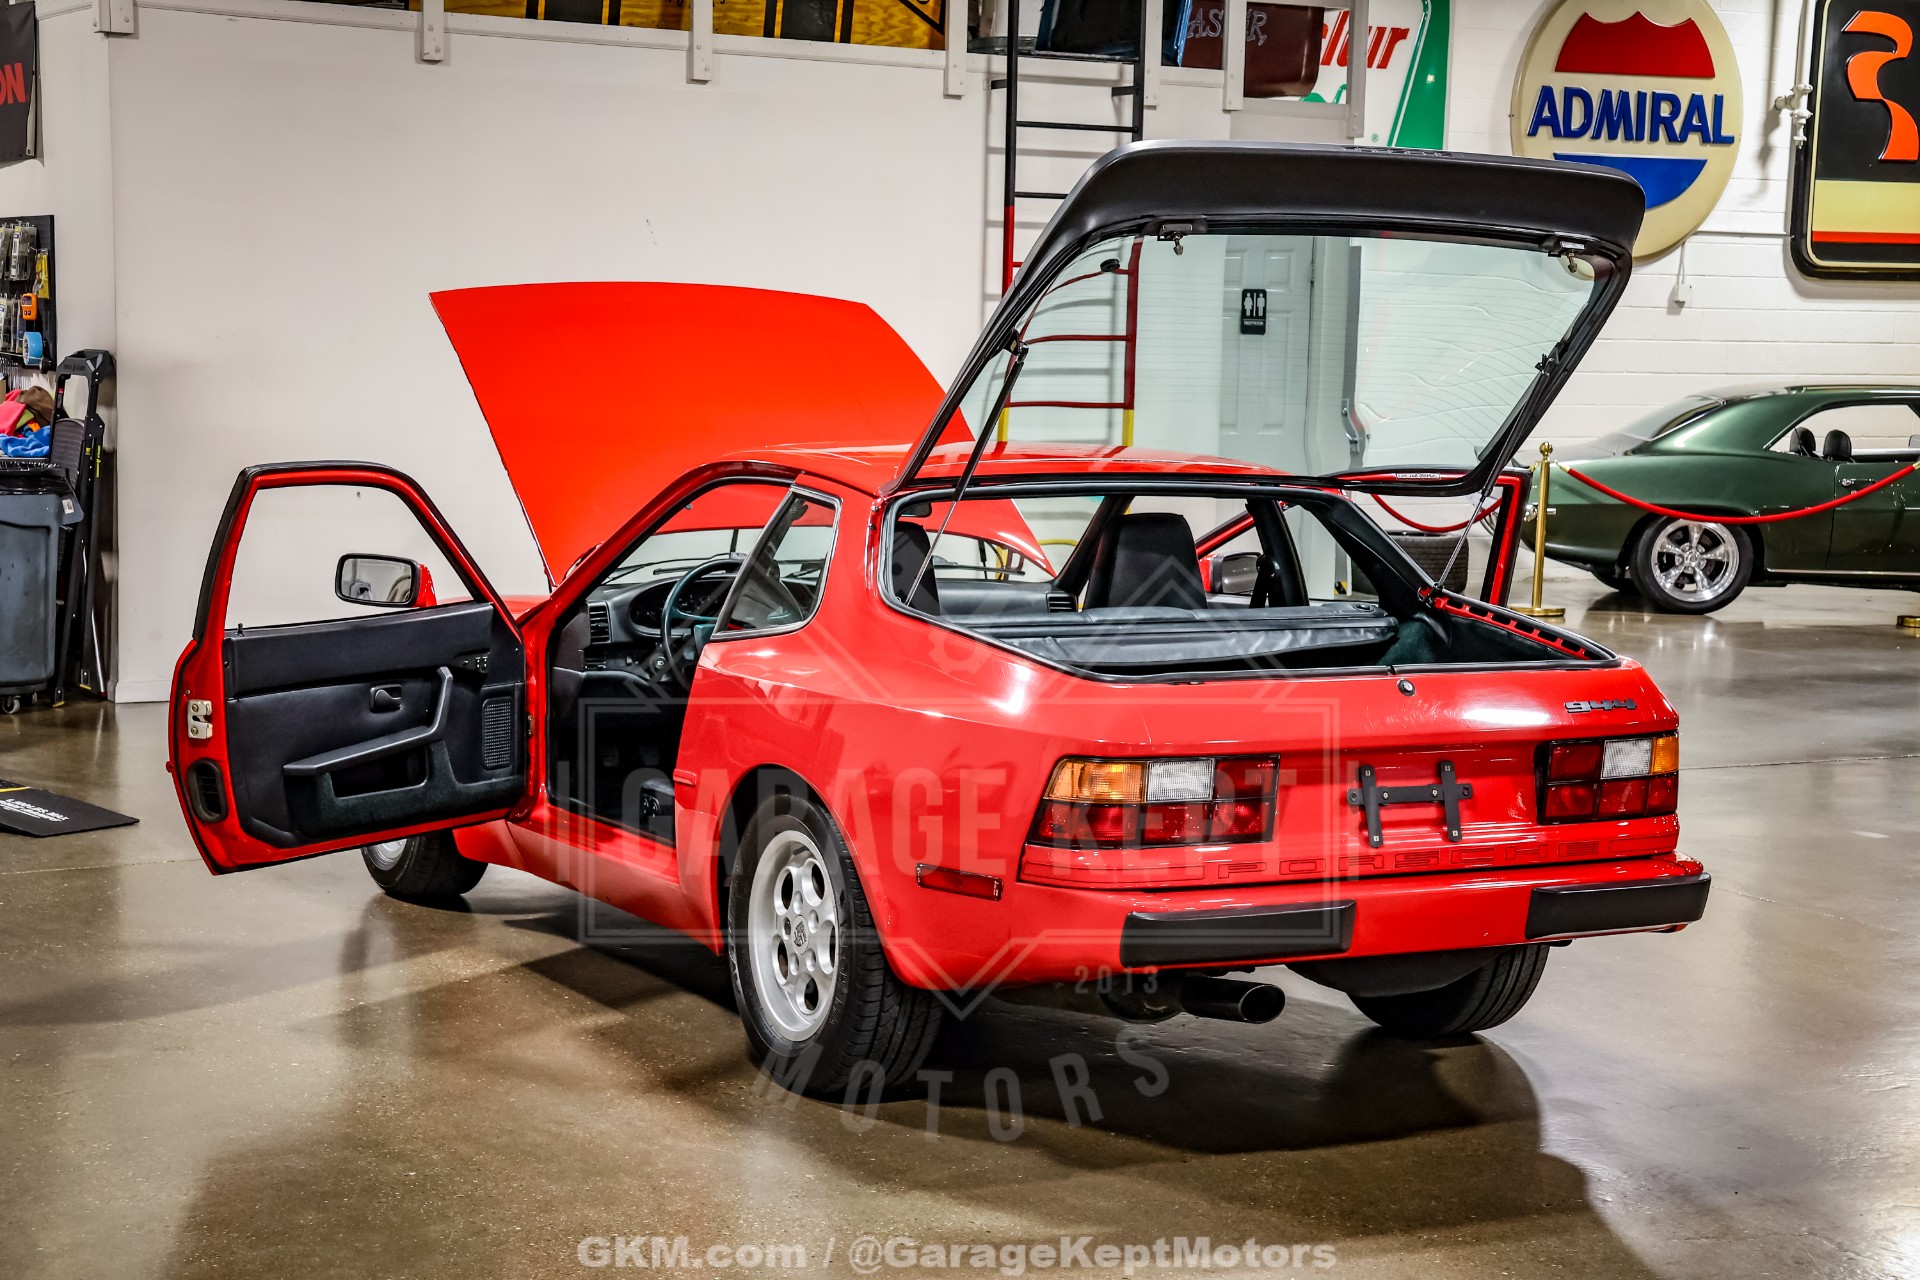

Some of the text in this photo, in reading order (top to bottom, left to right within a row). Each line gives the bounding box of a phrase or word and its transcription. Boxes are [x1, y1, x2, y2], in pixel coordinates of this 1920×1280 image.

[1526, 84, 1735, 145] ADMIRAL
[1564, 698, 1637, 714] 944
[1217, 840, 1600, 879] PORSCHE
